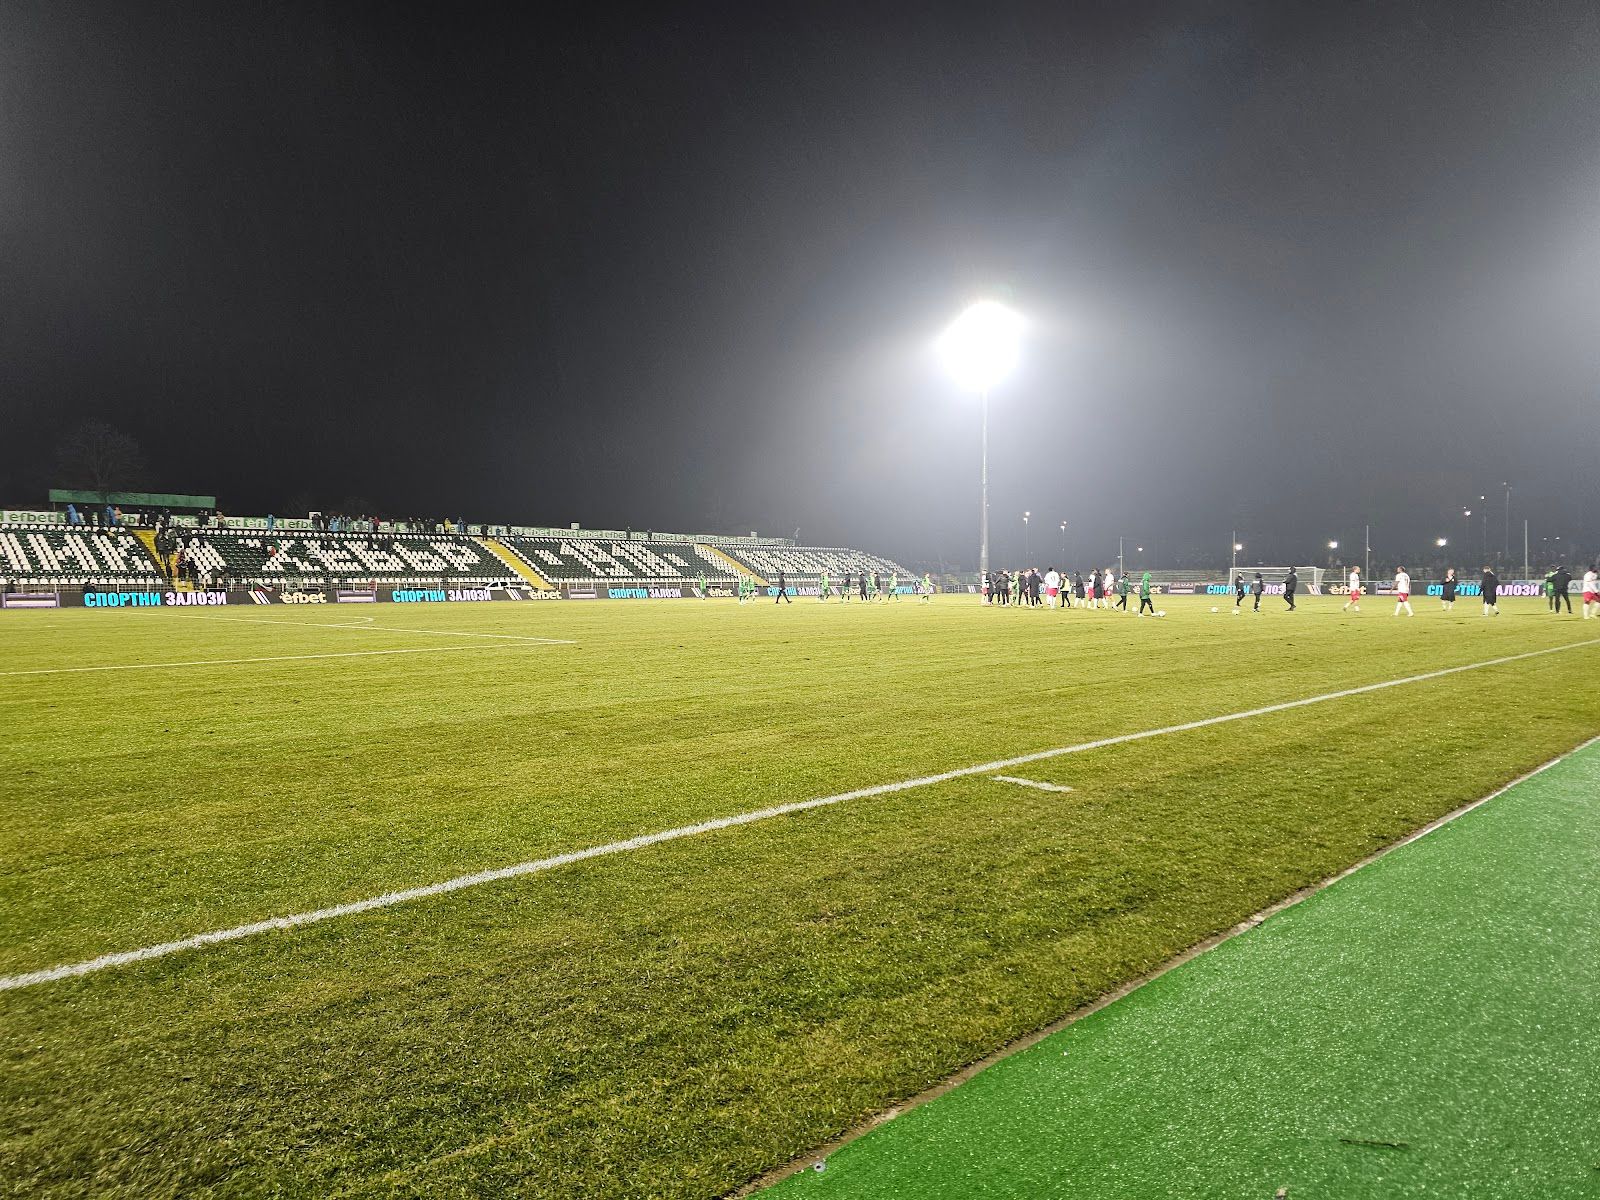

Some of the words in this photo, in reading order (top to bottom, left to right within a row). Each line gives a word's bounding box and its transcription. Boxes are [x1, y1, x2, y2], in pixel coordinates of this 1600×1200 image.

[9, 512, 54, 522] efbet
[249, 519, 282, 529] efbt
[553, 529, 577, 537] efbet
[528, 590, 562, 600] efbet
[608, 588, 648, 599] СПОРТНИ
[650, 588, 682, 599] ЗАЛОЗИ
[1206, 584, 1250, 595] СПОРТИ
[1496, 584, 1540, 596] АЛОЗИ
[84, 592, 161, 606] СПОРТНИ
[165, 591, 227, 605] ЗАЛОЗИ
[280, 592, 327, 604] efbet
[391, 590, 446, 602] СПОРТНИ
[447, 590, 491, 601] ЗАЛОЗИ
